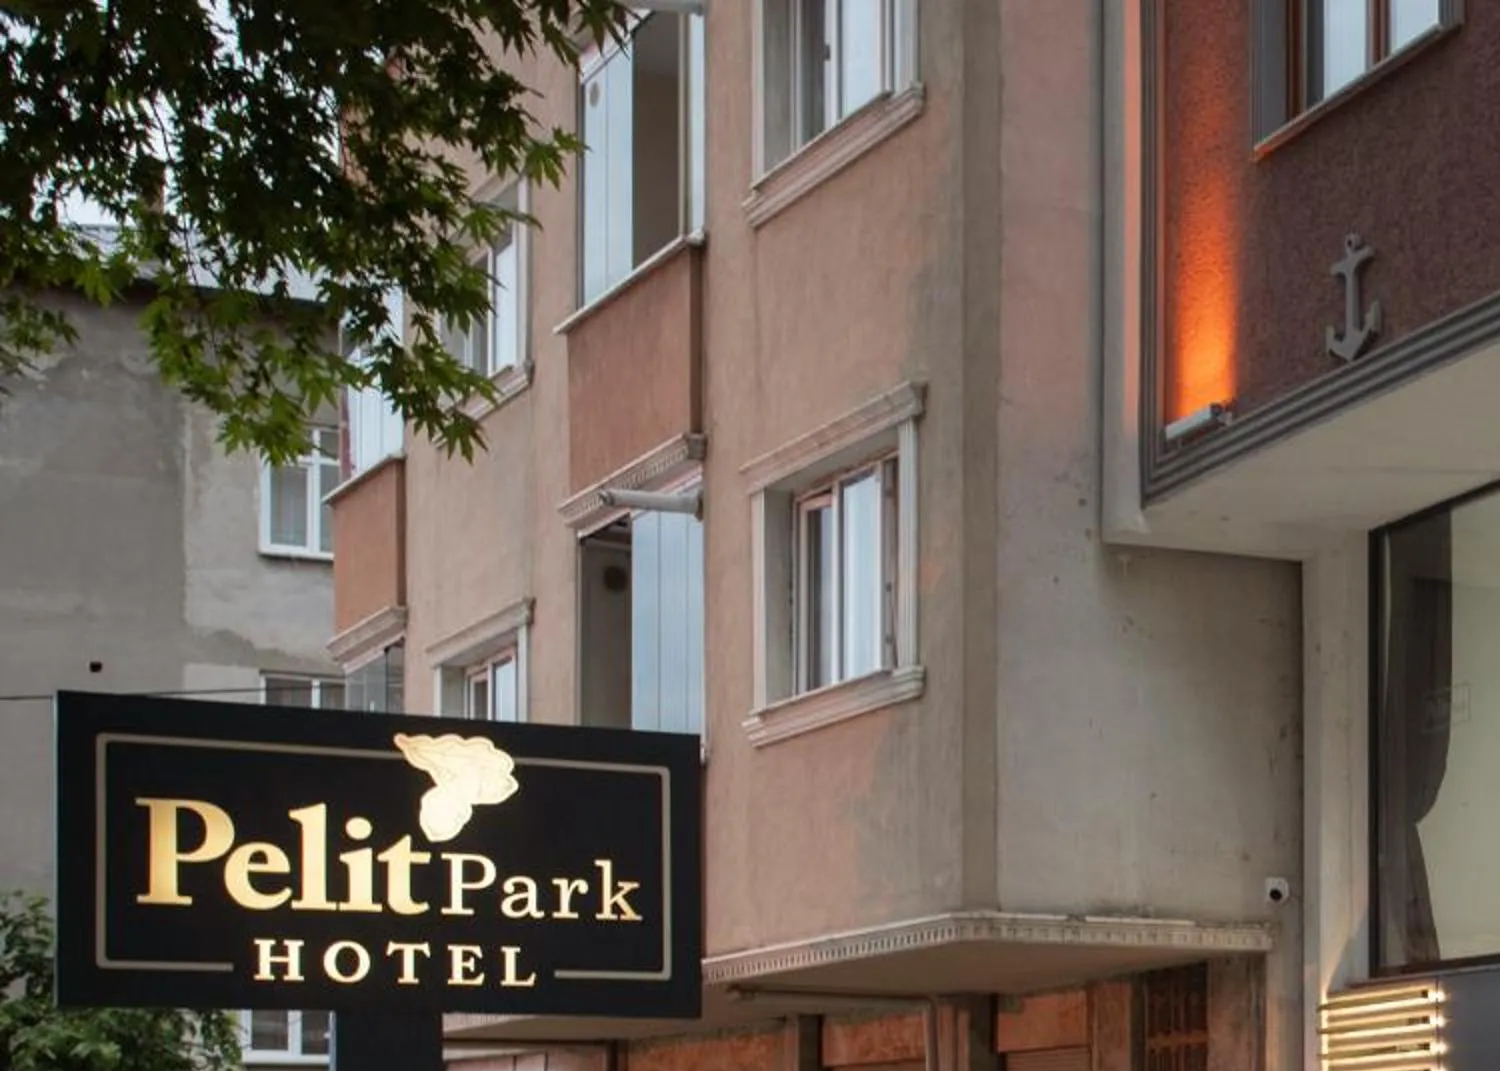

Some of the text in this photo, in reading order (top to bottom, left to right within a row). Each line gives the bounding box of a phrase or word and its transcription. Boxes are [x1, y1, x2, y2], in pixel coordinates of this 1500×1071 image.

[135, 797, 643, 922] Pelit Park
[253, 938, 537, 988] HOTEL
